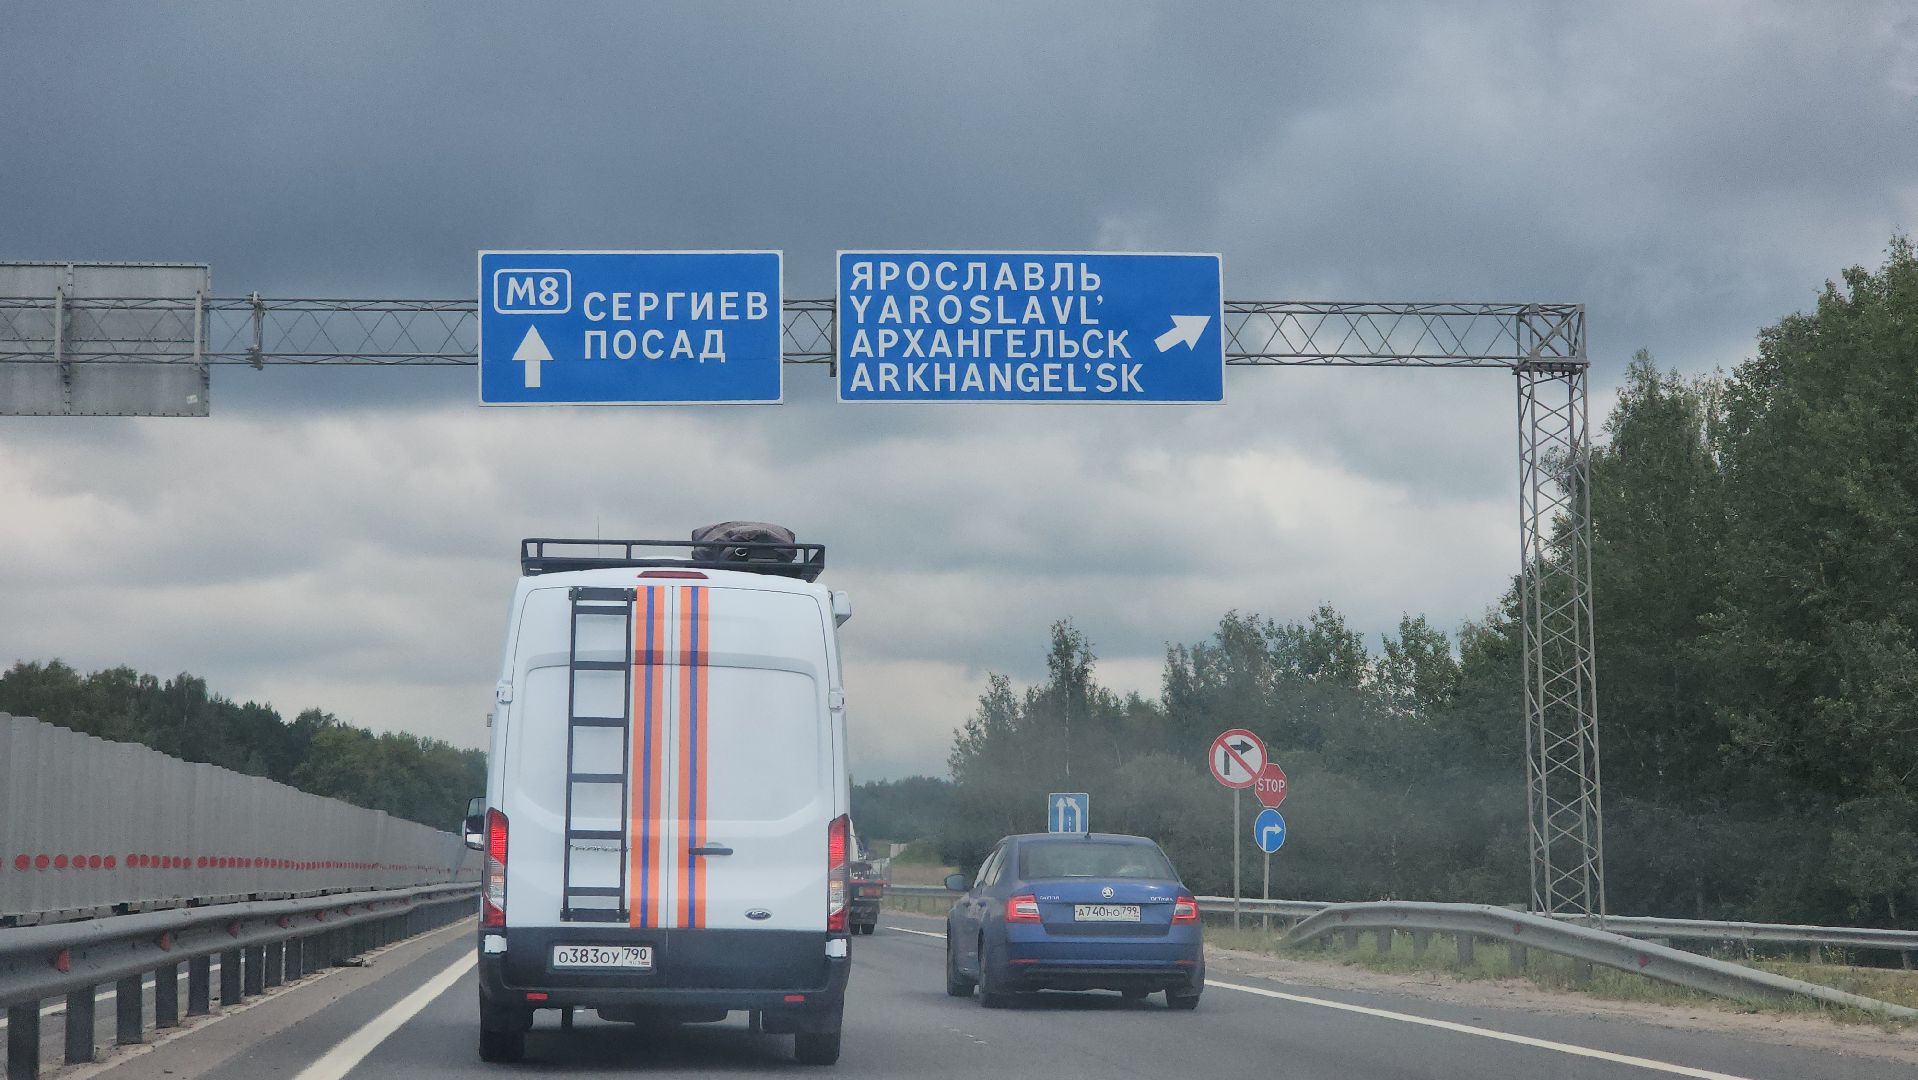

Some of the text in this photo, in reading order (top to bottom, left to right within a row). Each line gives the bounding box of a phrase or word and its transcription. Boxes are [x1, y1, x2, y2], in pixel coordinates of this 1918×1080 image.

[849, 261, 1101, 292] ЯРОСЛАВЛЬ
[583, 291, 768, 322] СЕРГИЕВ
[849, 295, 1104, 325] YAROSLAVL'
[583, 329, 726, 364] ПОСАД
[849, 329, 1132, 360] АРХАНГЕЛЬСК
[849, 362, 1145, 394] ARKHANGEL'SK
[1257, 777, 1286, 793] STOP
[623, 948, 647, 961] 790
